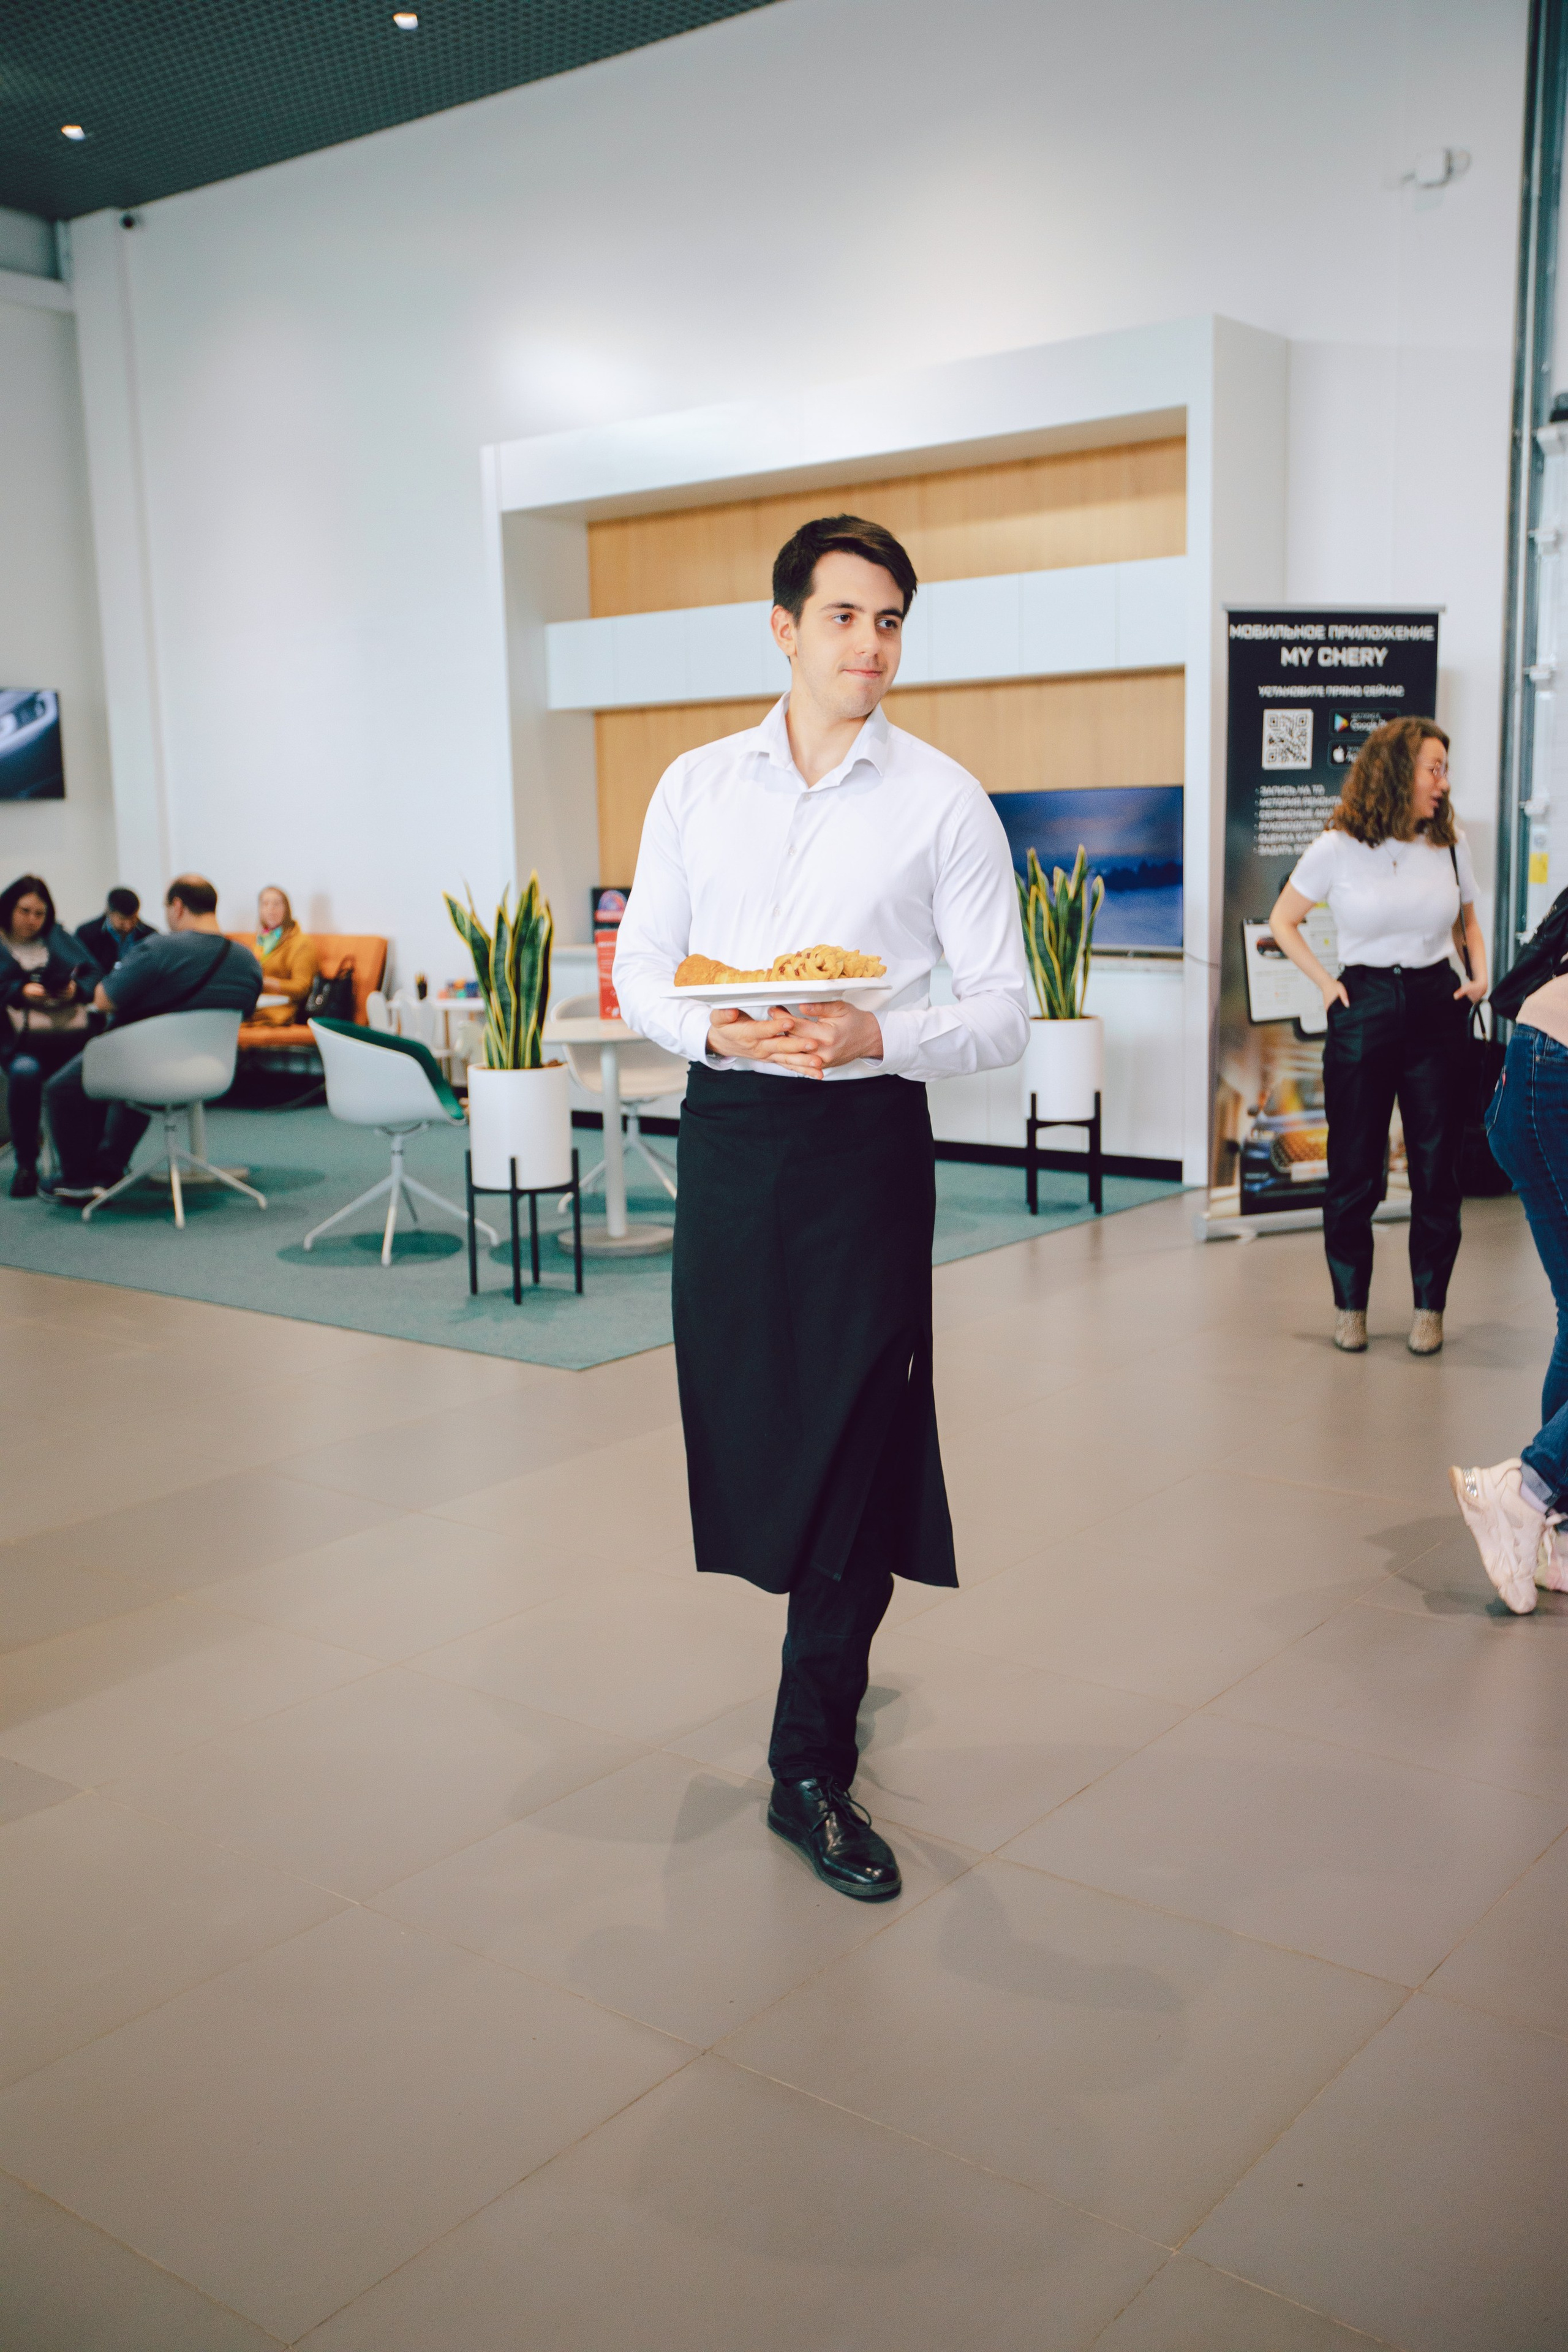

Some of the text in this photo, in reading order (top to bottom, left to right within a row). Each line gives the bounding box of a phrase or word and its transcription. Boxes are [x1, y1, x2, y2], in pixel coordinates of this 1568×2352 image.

[1229, 624, 1435, 641] МОБИЛЬНОЕ ПРИЛОЖЕНИЕ
[1280, 646, 1389, 667] MY CHERY
[1258, 684, 1405, 698] УСТАНОВИТЕ ПРЯМО СЕЙЧАС
